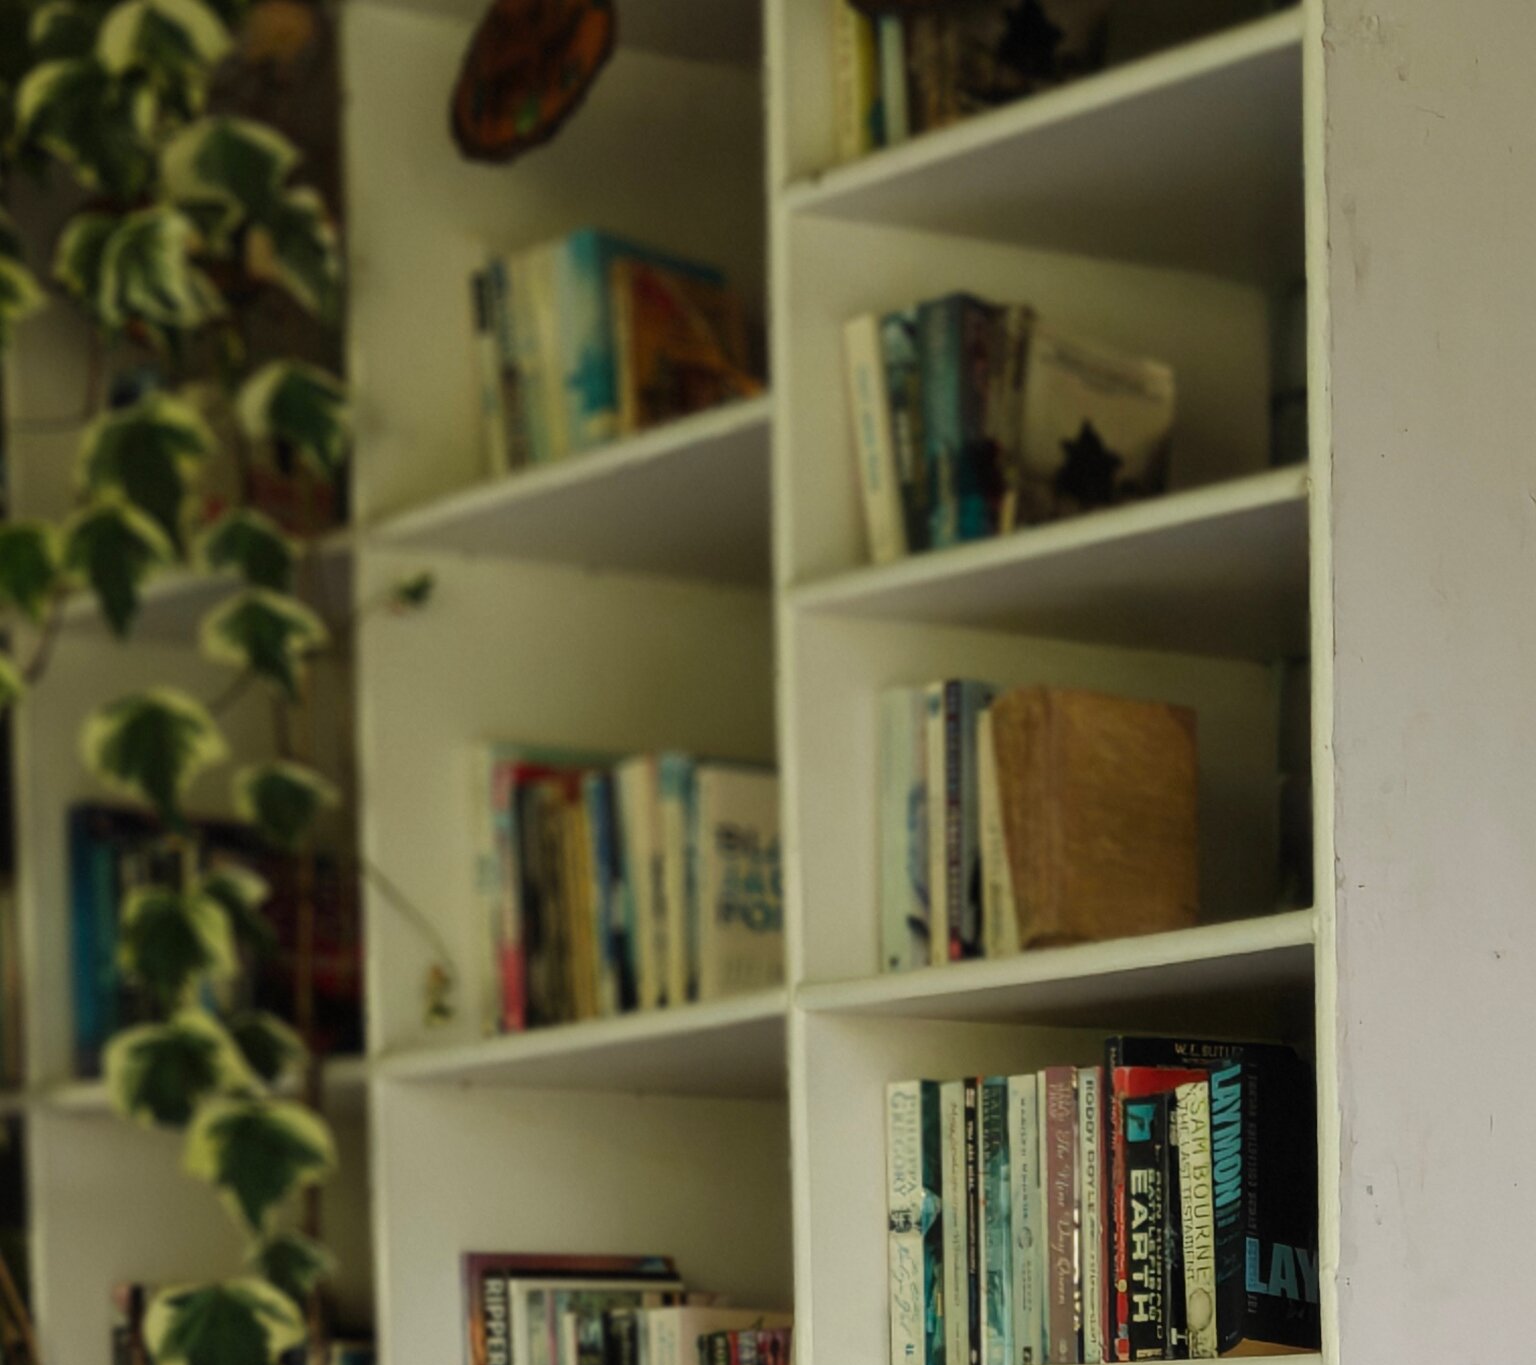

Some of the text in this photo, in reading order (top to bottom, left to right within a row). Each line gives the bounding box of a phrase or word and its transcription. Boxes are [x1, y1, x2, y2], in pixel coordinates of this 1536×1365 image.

[891, 1091, 908, 1196] GREGORY
[1085, 1080, 1095, 1144] RODDY
[1180, 1140, 1192, 1174] LAST
[1212, 1064, 1242, 1208] LAYMON
[1086, 1150, 1097, 1214] DOYLE
[1182, 1176, 1195, 1281] TESTAMENT
[1190, 1099, 1212, 1283] SAM BOURNE
[1130, 1168, 1149, 1323] EARTH
[1148, 1168, 1157, 1321] BATTLEFIELD
